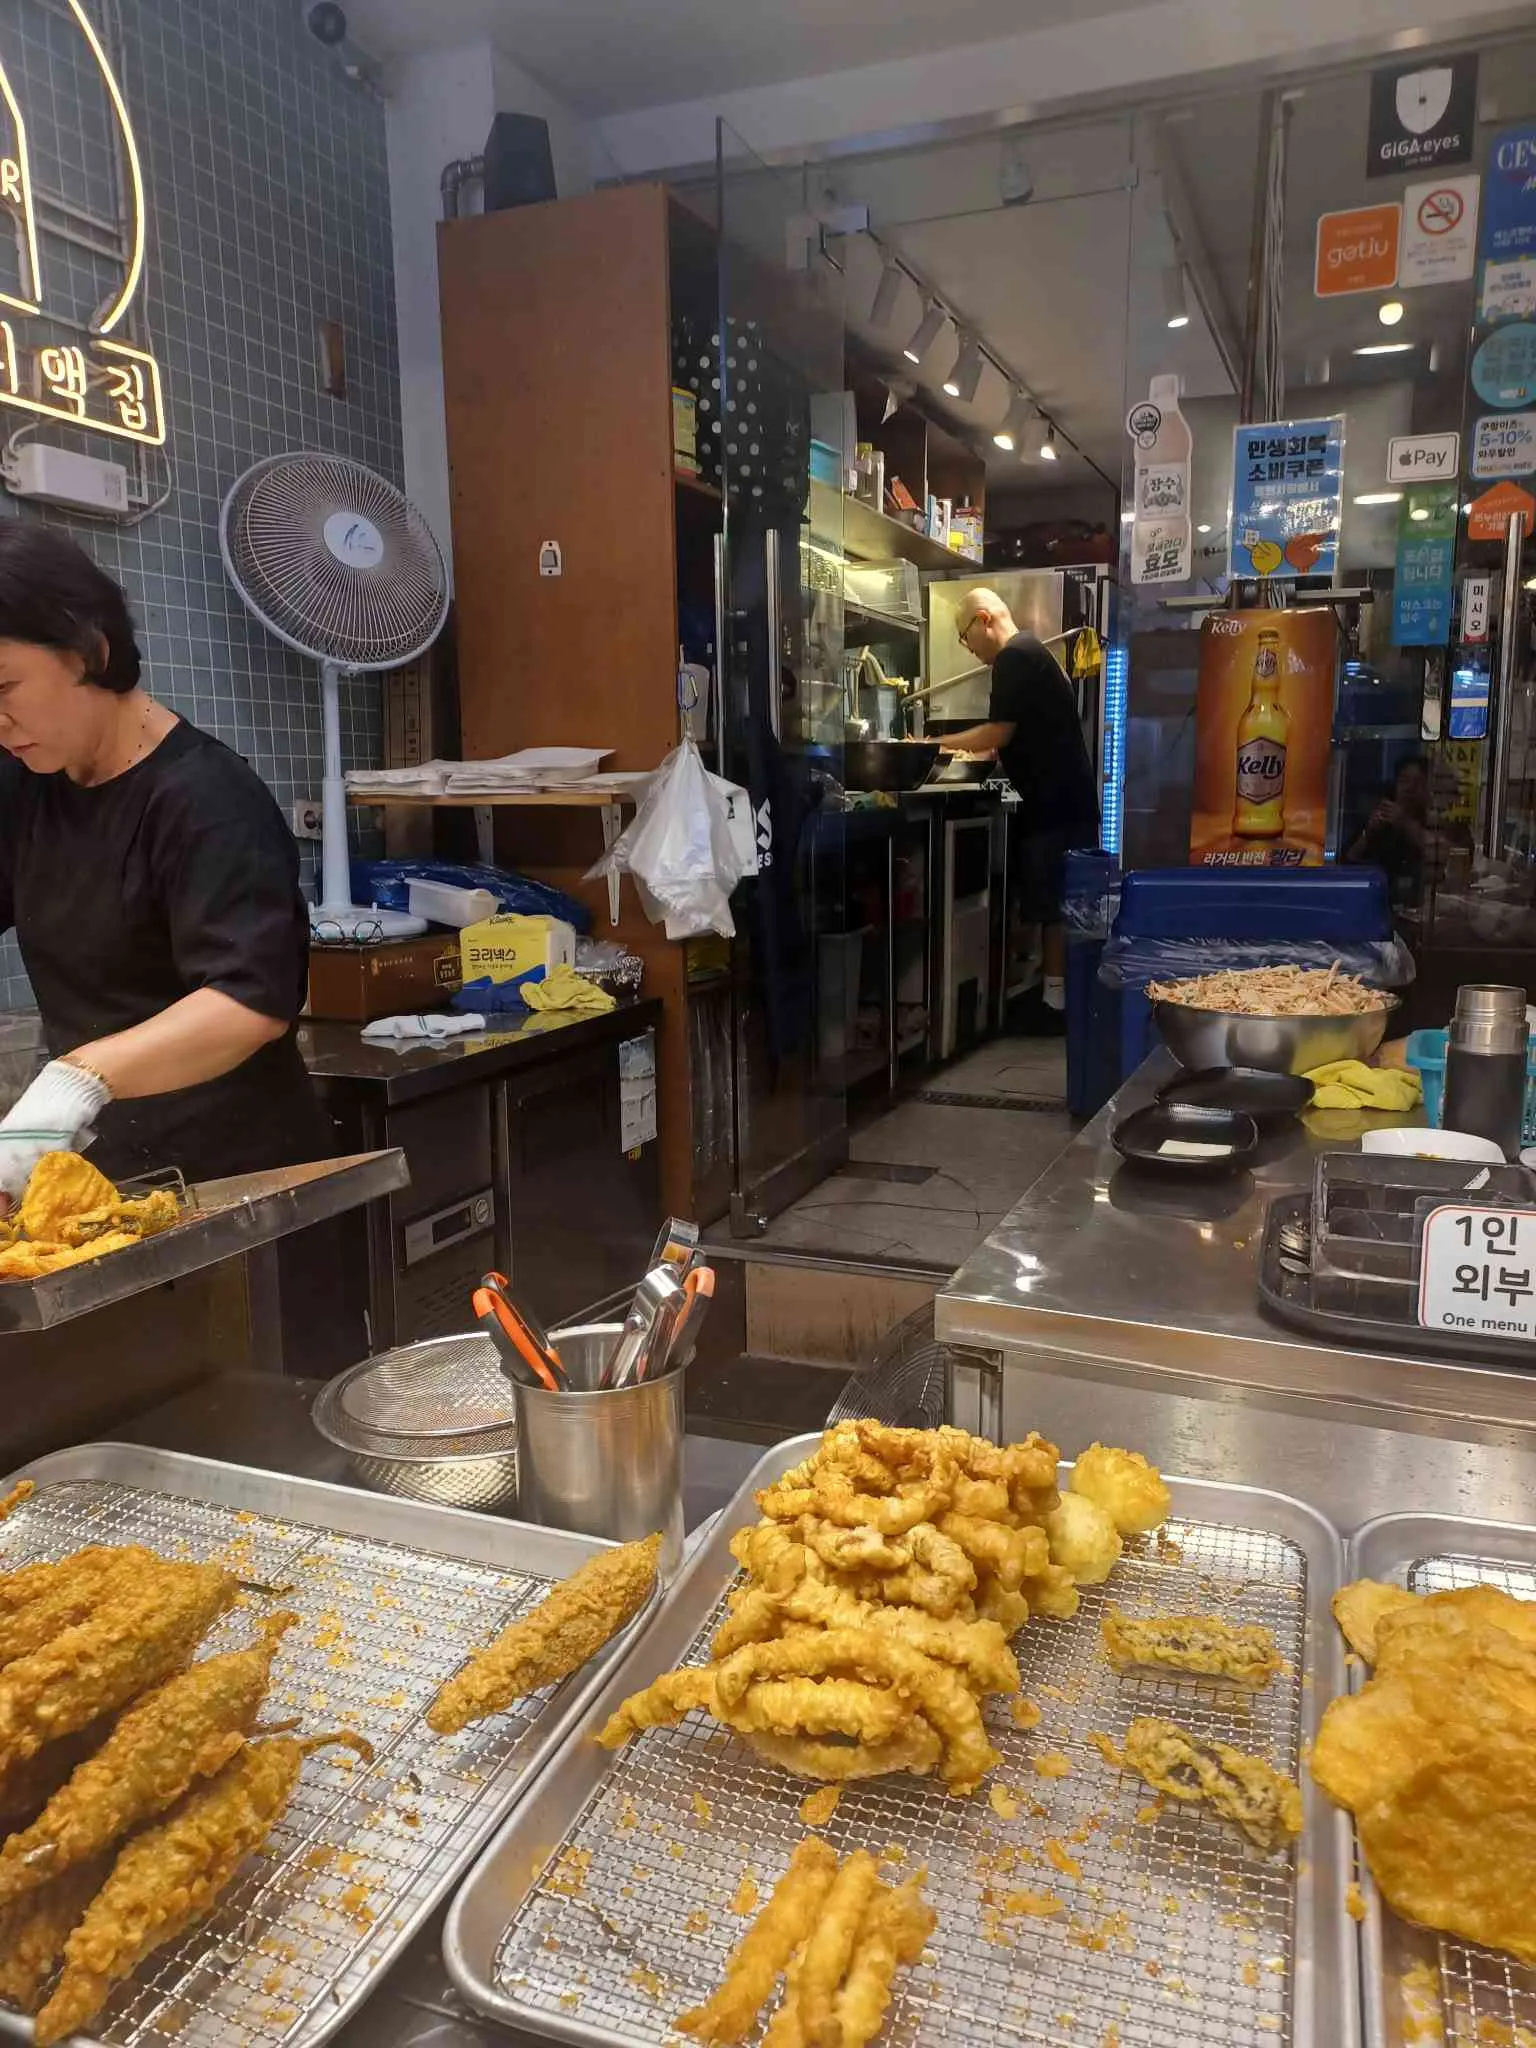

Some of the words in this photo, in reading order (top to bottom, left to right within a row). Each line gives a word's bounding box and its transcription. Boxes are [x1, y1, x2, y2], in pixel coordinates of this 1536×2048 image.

[1481, 430, 1533, 447] 5-10%
[1413, 449, 1448, 468] Pay
[1469, 585, 1484, 631] 미시오
[1211, 620, 1247, 636] Kelly
[1239, 756, 1284, 779] Kelly
[469, 948, 516, 963] 크리넥스
[1455, 1215, 1518, 1256] 1인
[1451, 1264, 1534, 1307] 외부
[1442, 1312, 1476, 1328] One
[1481, 1318, 1528, 1333] menu
